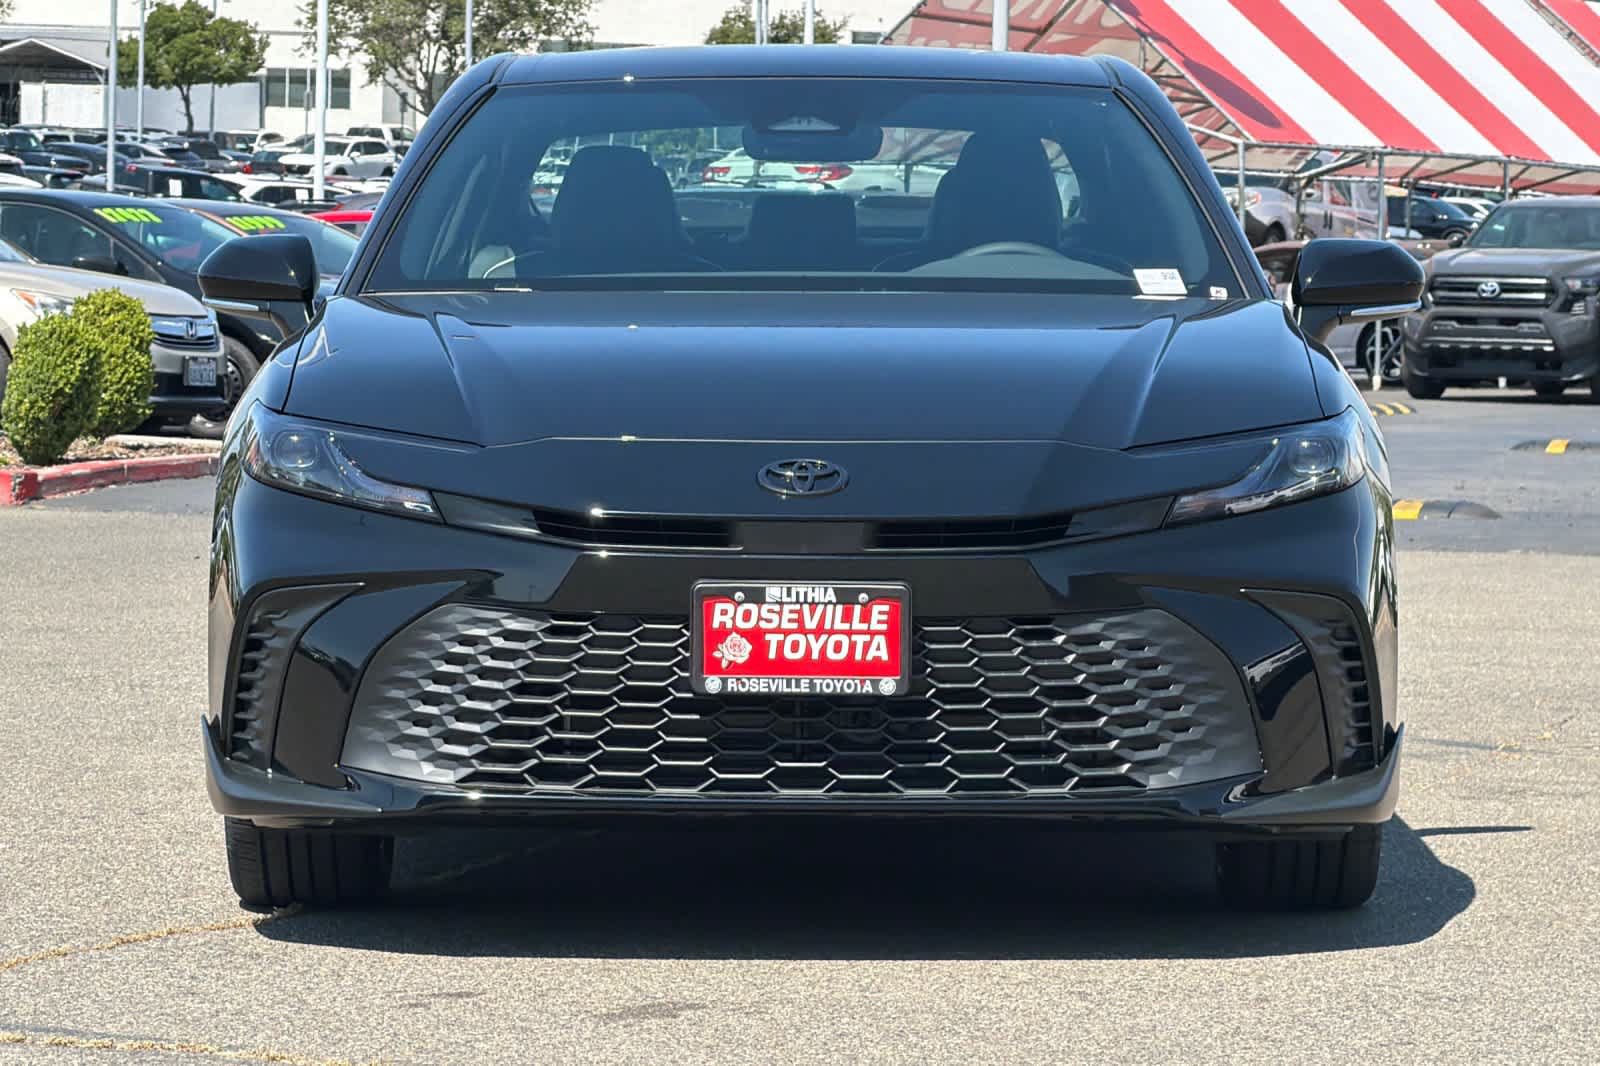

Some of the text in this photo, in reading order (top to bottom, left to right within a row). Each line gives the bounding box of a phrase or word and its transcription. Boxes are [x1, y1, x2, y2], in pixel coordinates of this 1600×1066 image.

[781, 587, 837, 603] LITHIA
[712, 603, 889, 630] ROSEVILLE
[765, 634, 889, 661] TOYOTA
[727, 678, 873, 694] ROSEVILLE TOYOTA
